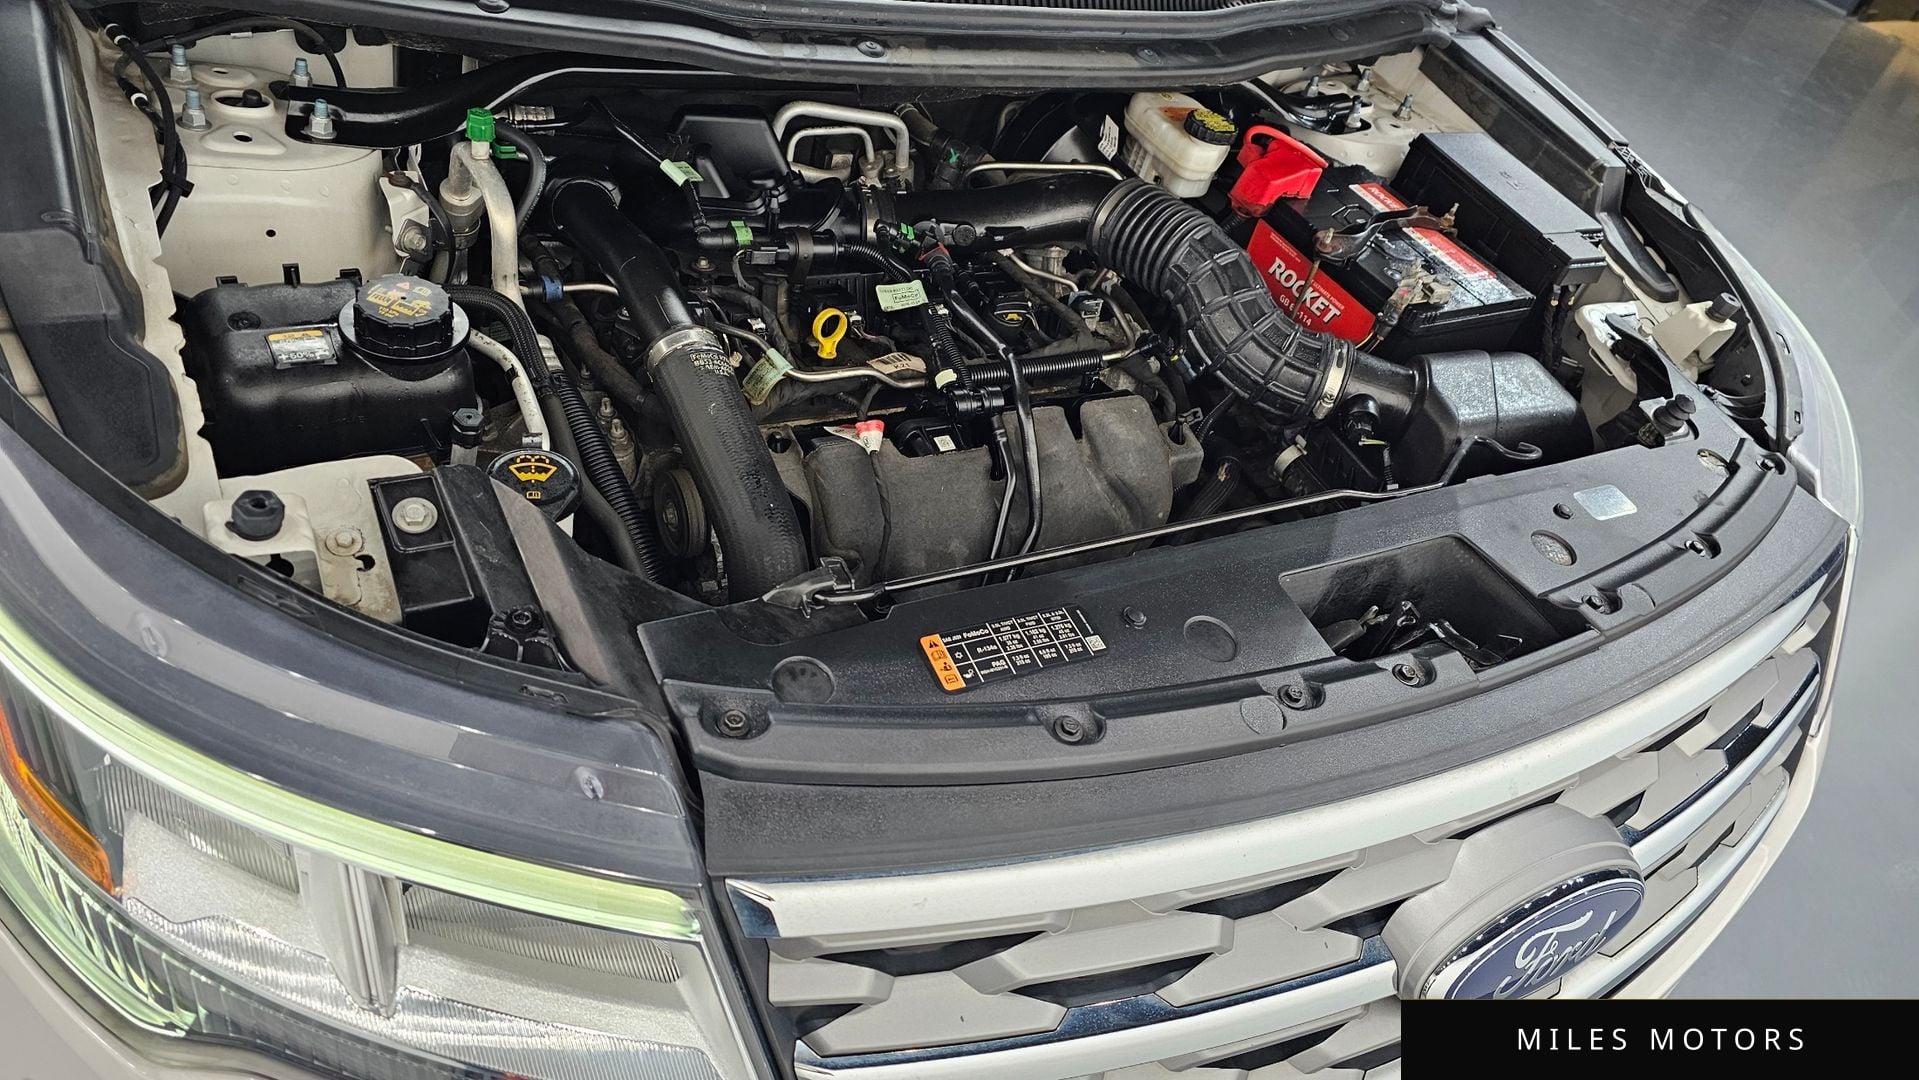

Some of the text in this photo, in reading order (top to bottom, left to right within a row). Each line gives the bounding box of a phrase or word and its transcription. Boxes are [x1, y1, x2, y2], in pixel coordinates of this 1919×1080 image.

[1268, 257, 1340, 323] ROCKET
[962, 629, 989, 638] FoMoCo
[1493, 910, 1617, 999] Ford
